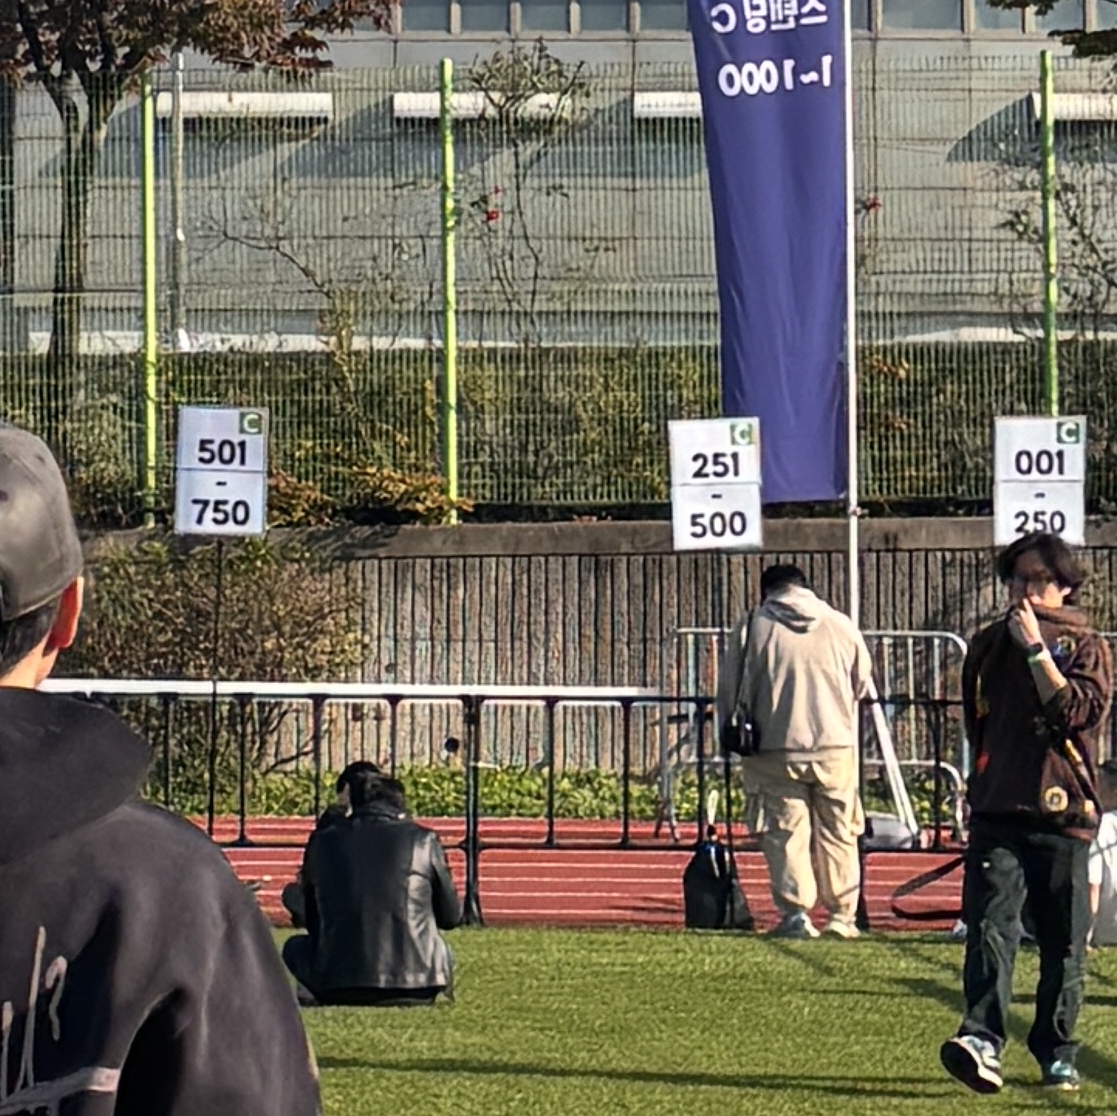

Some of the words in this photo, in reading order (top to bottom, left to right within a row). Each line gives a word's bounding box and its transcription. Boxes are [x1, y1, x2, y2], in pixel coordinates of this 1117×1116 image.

[243, 414, 260, 433] C
[734, 423, 751, 445] C
[1059, 423, 1077, 442] C
[198, 438, 247, 466] 501
[691, 451, 740, 478] 251
[1015, 449, 1065, 476] 001
[191, 499, 250, 526] 750
[690, 511, 747, 538] 500
[1014, 510, 1066, 534] 250
